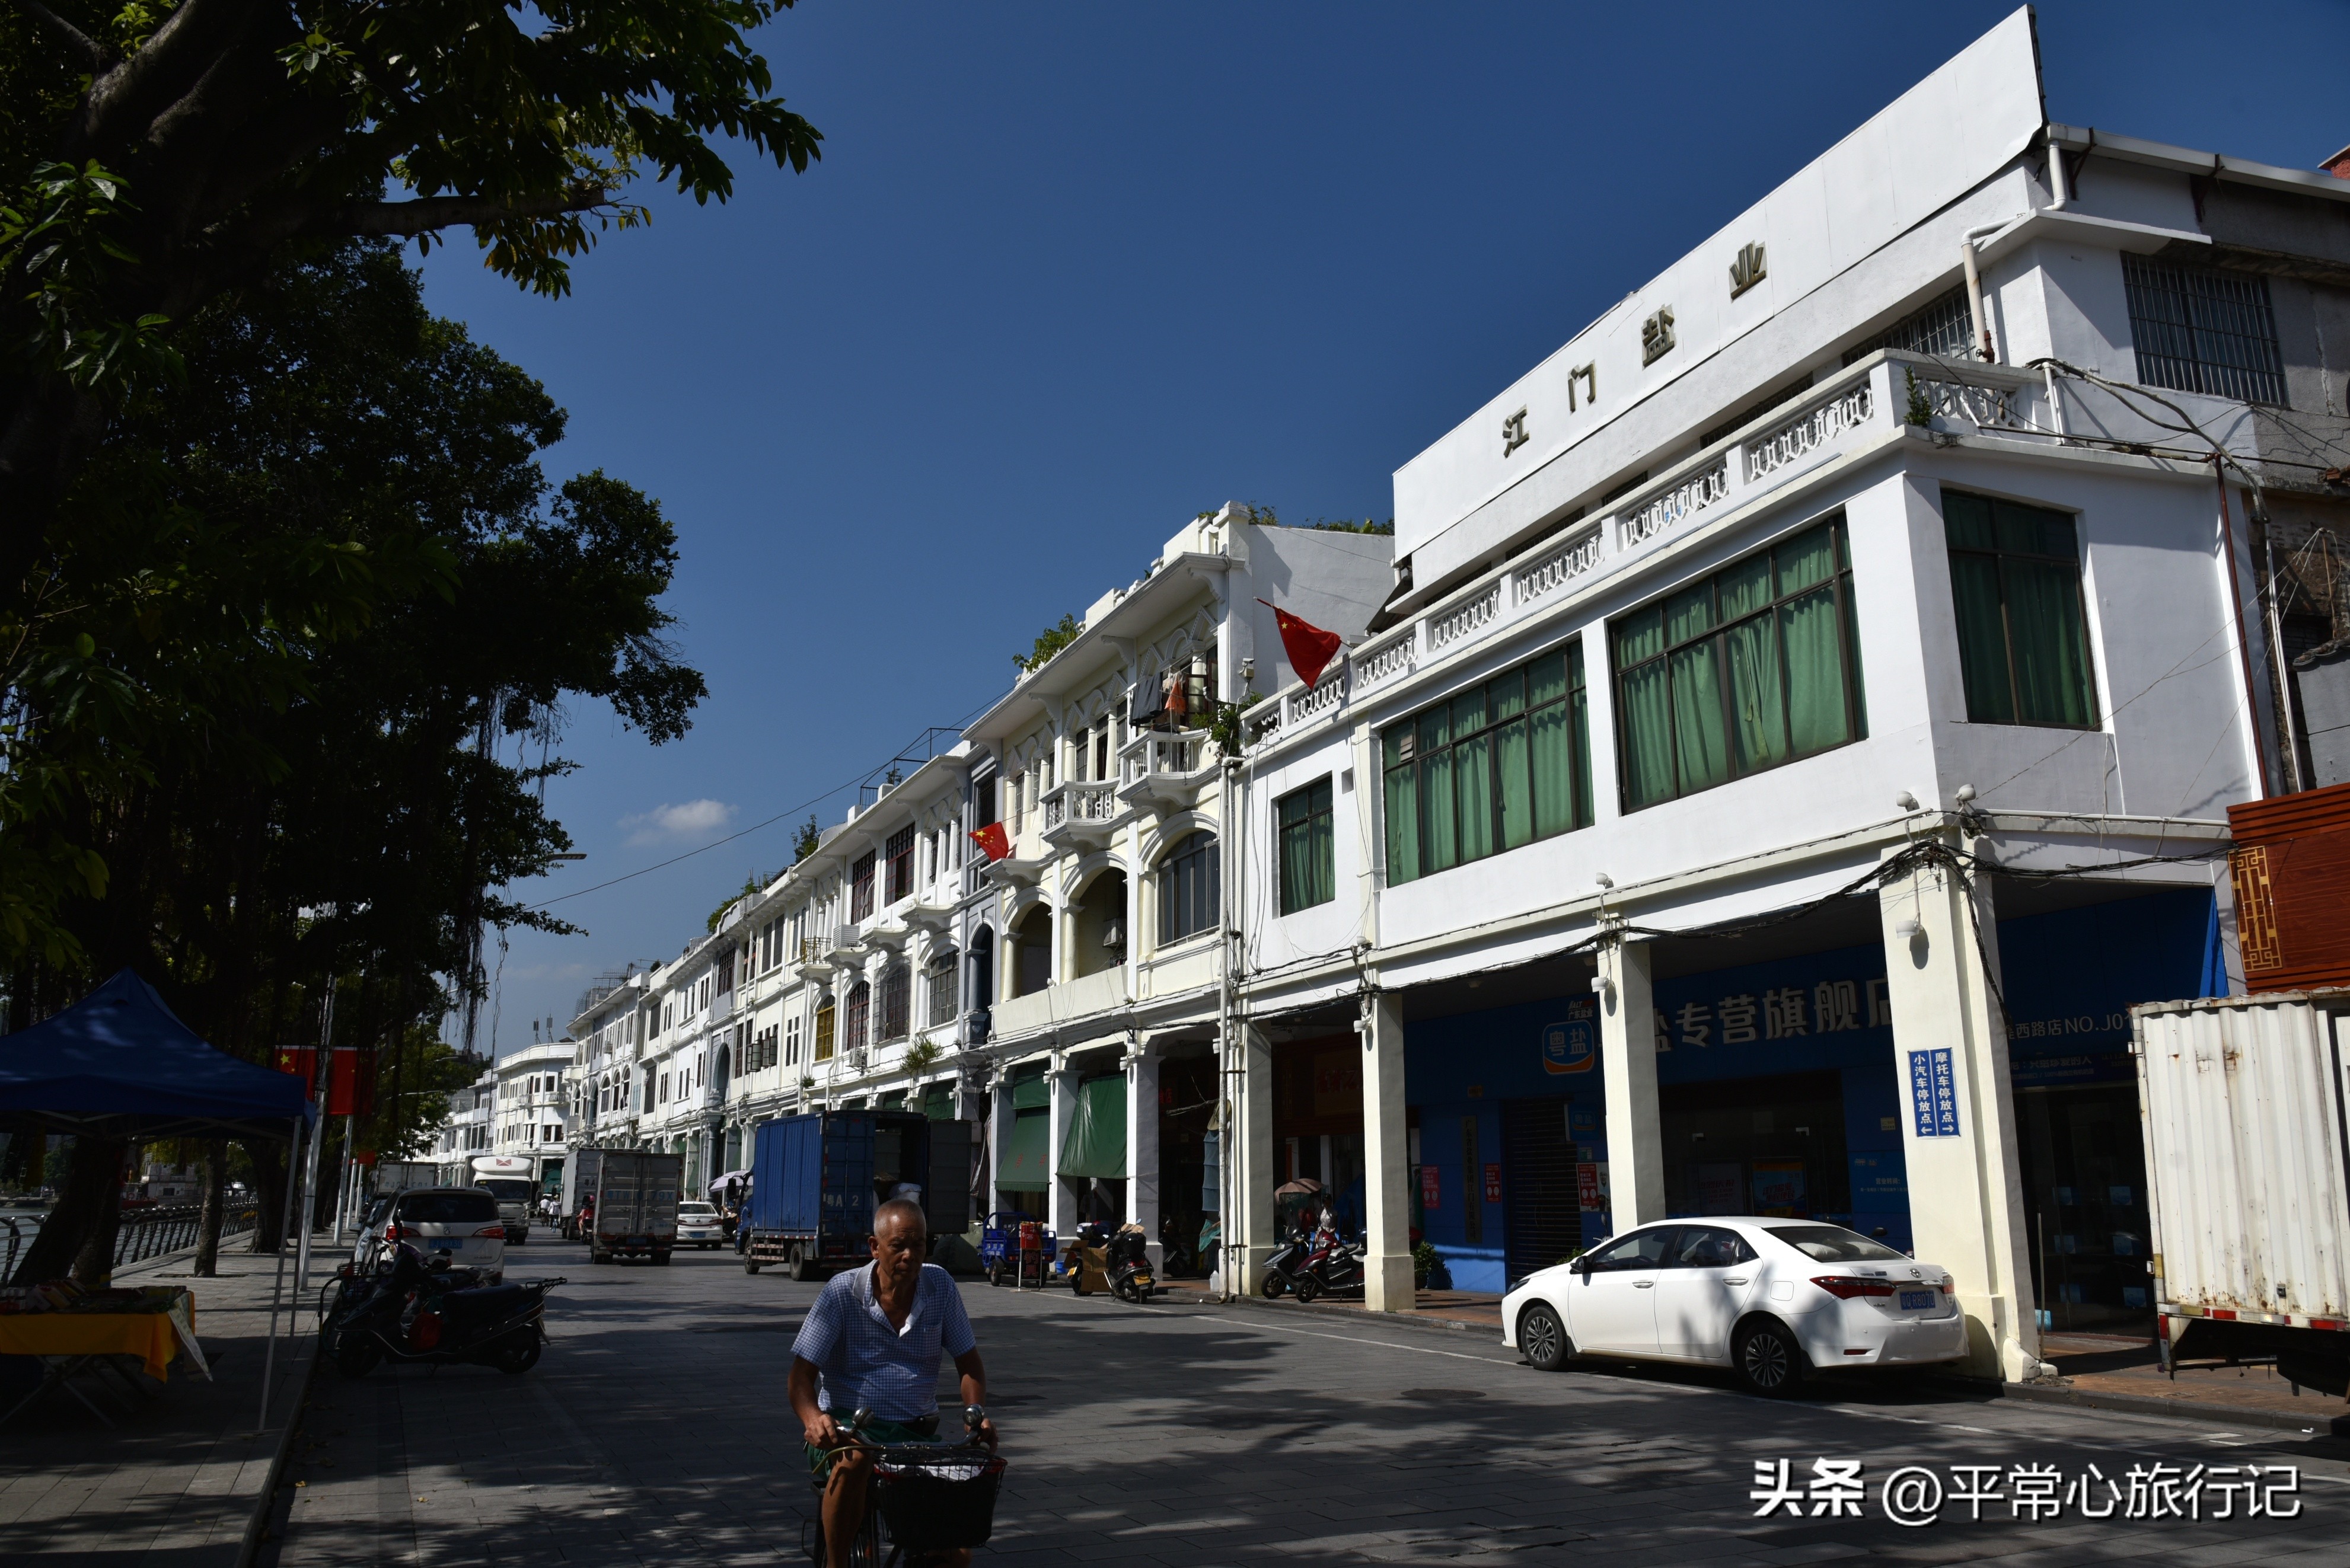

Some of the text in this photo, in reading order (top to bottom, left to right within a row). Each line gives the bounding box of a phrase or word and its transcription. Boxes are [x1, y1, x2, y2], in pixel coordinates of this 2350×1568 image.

[1503, 243, 1766, 457] 江门盐业
[1548, 1027, 1588, 1057] 粤盐
[1568, 1008, 1593, 1021] 广东盐业
[1914, 1054, 1933, 1124] 小汽车停放点
[1935, 1052, 1954, 1123] 摩托车停放点
